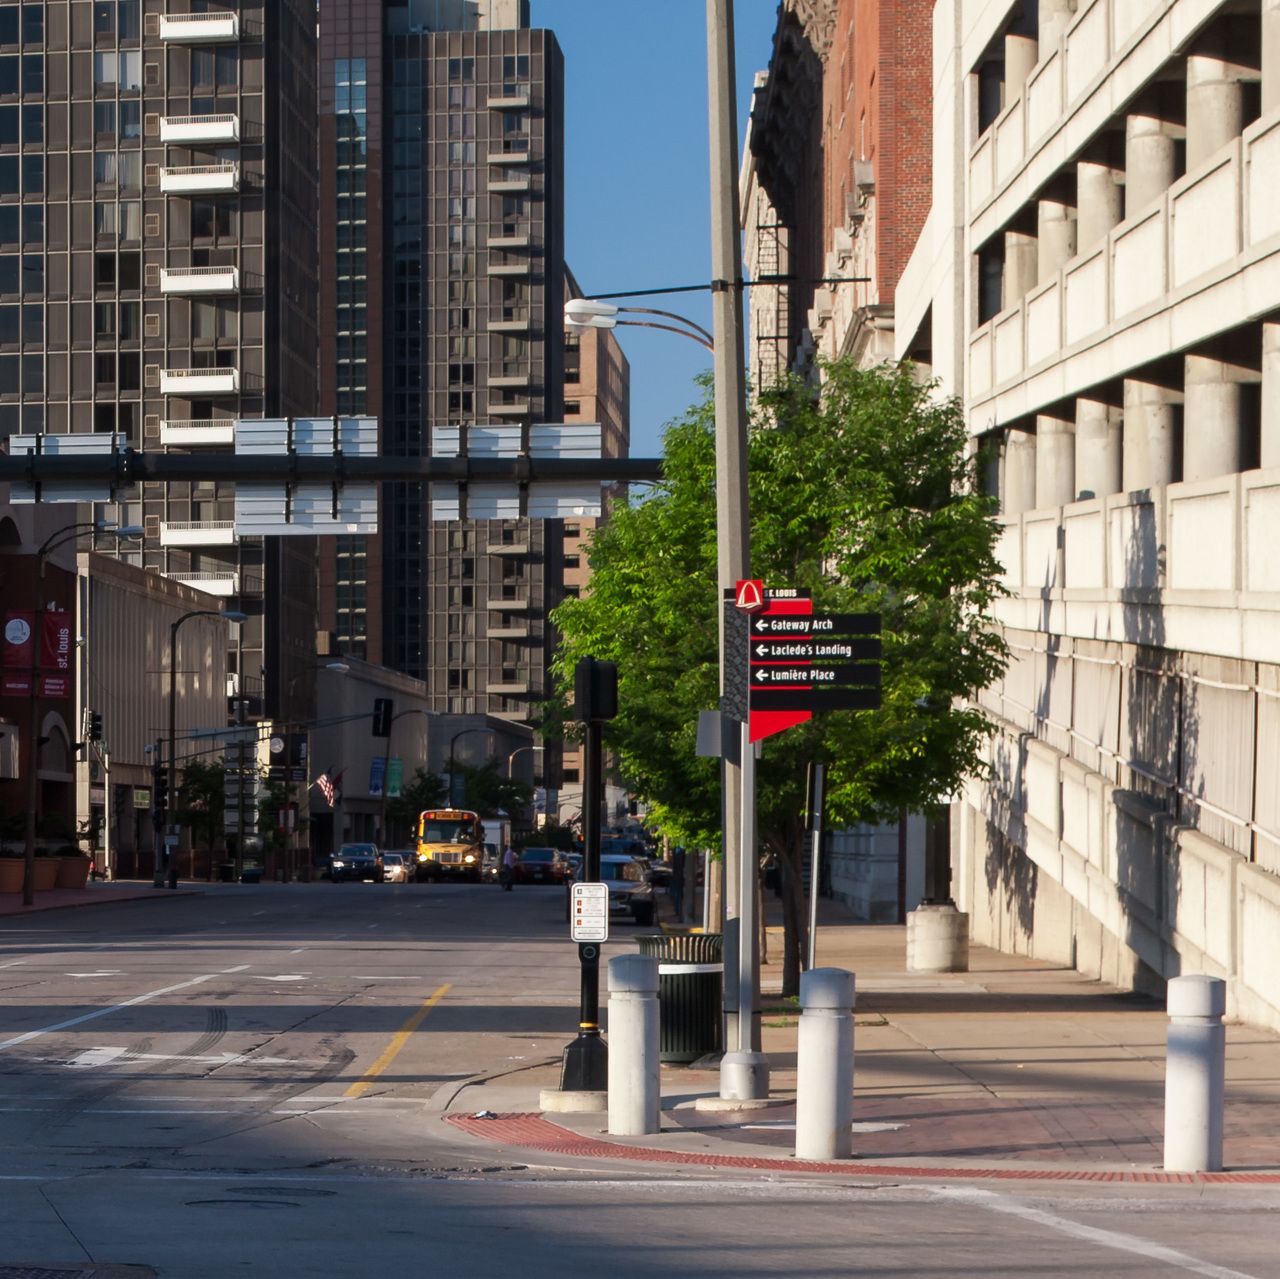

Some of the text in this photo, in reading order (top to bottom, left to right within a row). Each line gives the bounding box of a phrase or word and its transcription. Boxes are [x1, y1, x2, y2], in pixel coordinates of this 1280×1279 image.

[776, 589, 797, 598] LOUIS
[771, 619, 833, 632] Gateway Arch
[57, 628, 69, 669] st. louis
[771, 644, 852, 658] Laclede's Landing
[771, 669, 835, 681] Lumière Place
